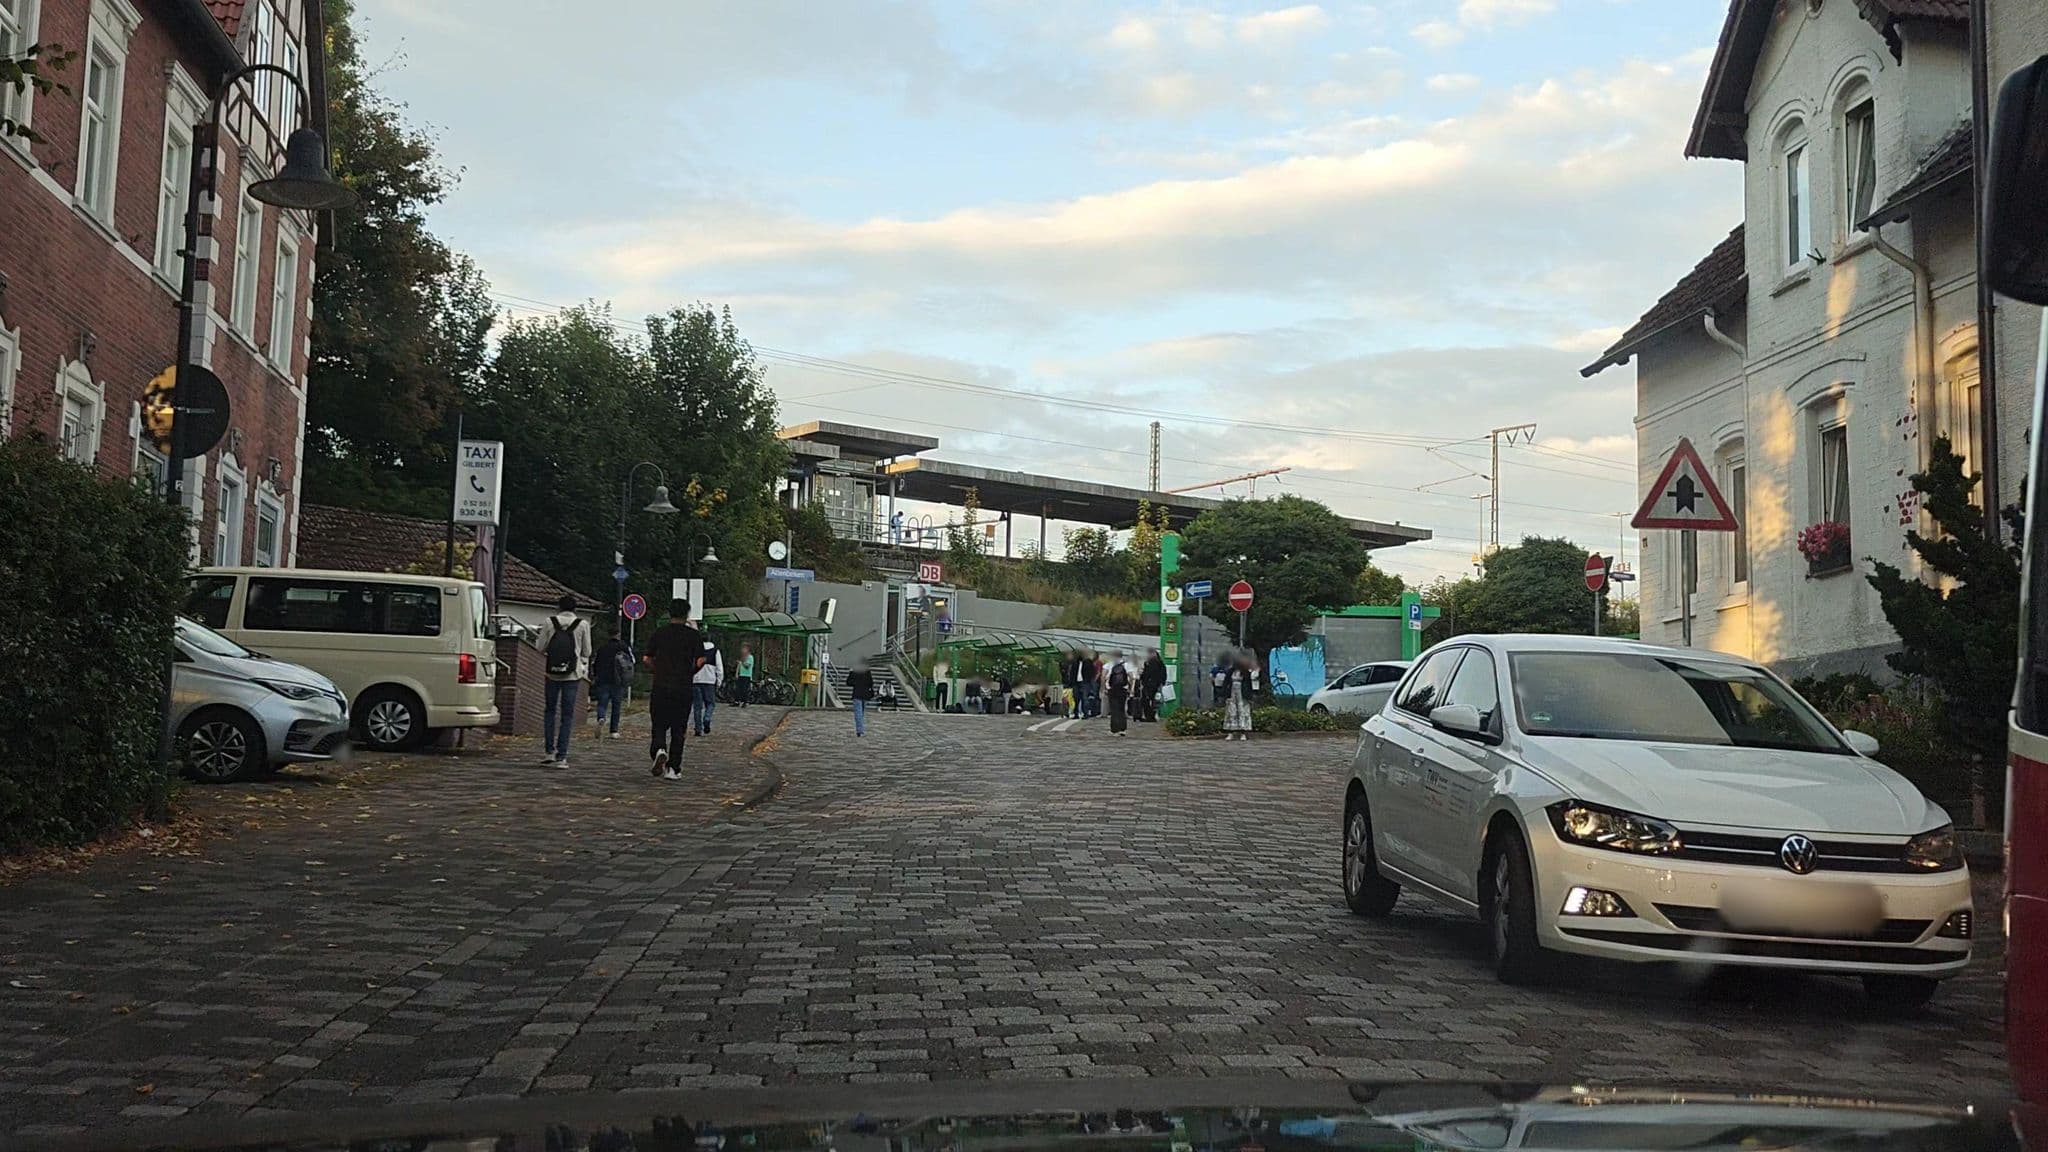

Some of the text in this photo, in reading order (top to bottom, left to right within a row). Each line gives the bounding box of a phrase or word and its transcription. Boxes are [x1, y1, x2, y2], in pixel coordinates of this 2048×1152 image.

[464, 446, 496, 459] TAXI
[462, 460, 495, 468] GILBERT
[459, 508, 475, 516] 930
[921, 566, 939, 579] DB
[1412, 605, 1419, 618] P
